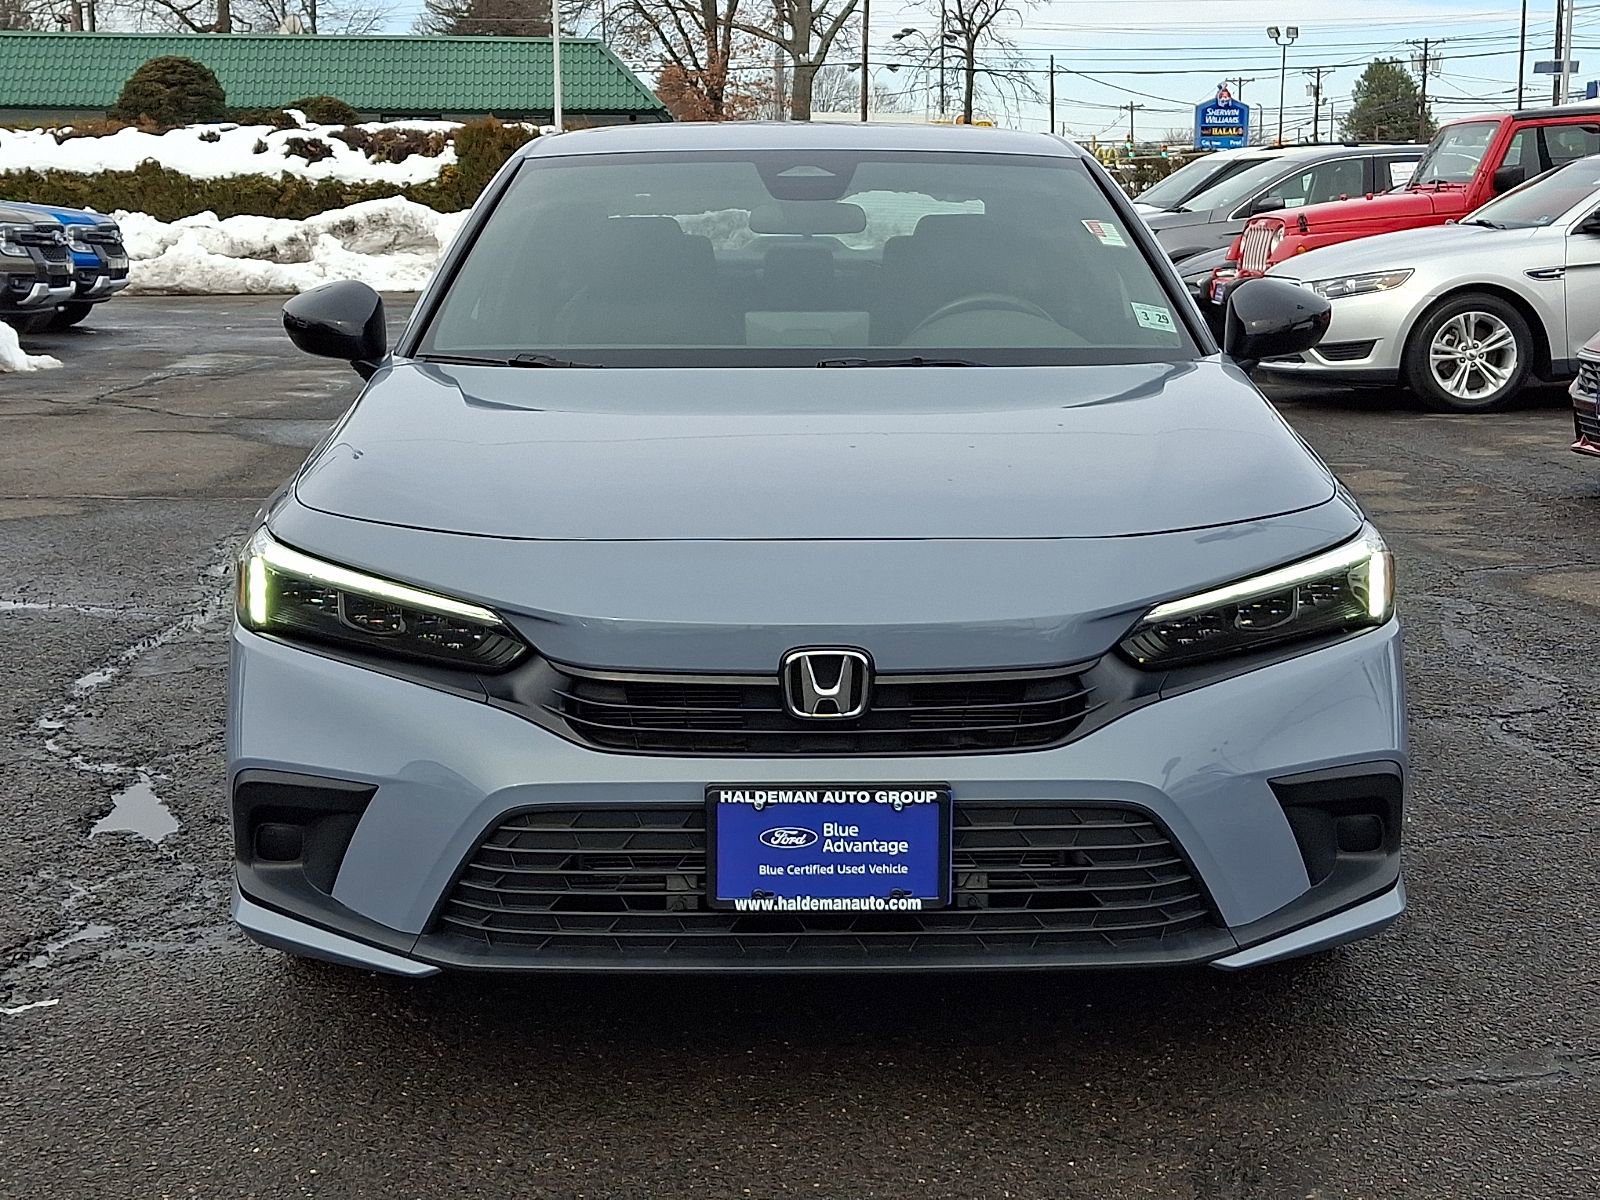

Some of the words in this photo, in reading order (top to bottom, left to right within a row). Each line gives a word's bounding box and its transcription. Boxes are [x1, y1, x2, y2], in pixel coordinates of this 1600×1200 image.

[1206, 108, 1239, 116] SHERWIN
[1212, 127, 1237, 135] HALAL
[1141, 311, 1150, 321] 3
[1155, 313, 1169, 324] 29
[719, 790, 818, 804] HALDEMAN
[822, 790, 870, 804] AUTO
[874, 790, 938, 804] GROUP
[822, 822, 859, 837] Blue
[770, 830, 807, 845] Ford
[822, 838, 909, 855] Advantage
[758, 864, 783, 875] Blue
[787, 864, 834, 875] Certified
[837, 864, 866, 875] Used
[869, 864, 908, 875] Vehicle
[734, 896, 922, 911] www.haldemanauto.com
